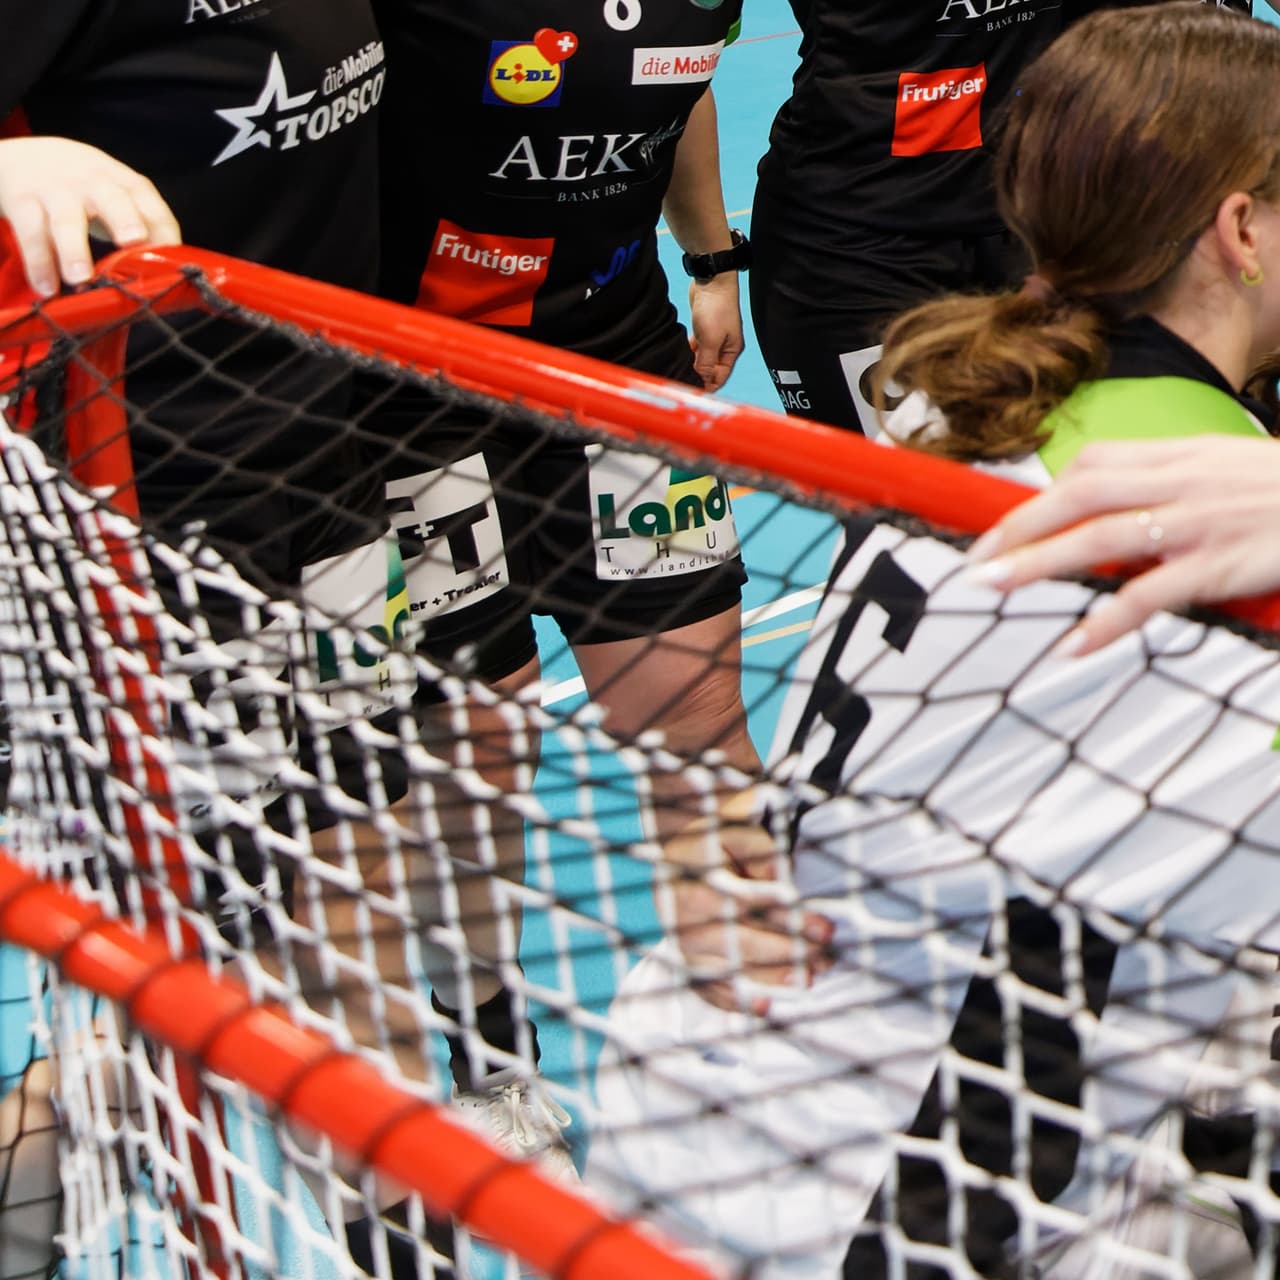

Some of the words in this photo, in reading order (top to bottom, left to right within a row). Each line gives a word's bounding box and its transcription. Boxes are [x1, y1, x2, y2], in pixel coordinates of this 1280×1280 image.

[641, 56, 670, 76] die
[322, 67, 345, 96] die
[901, 75, 984, 104] Frutiger
[489, 132, 646, 182] AEK
[557, 189, 601, 203] BANK
[604, 182, 628, 197] 1826
[435, 233, 548, 276] Frutiger
